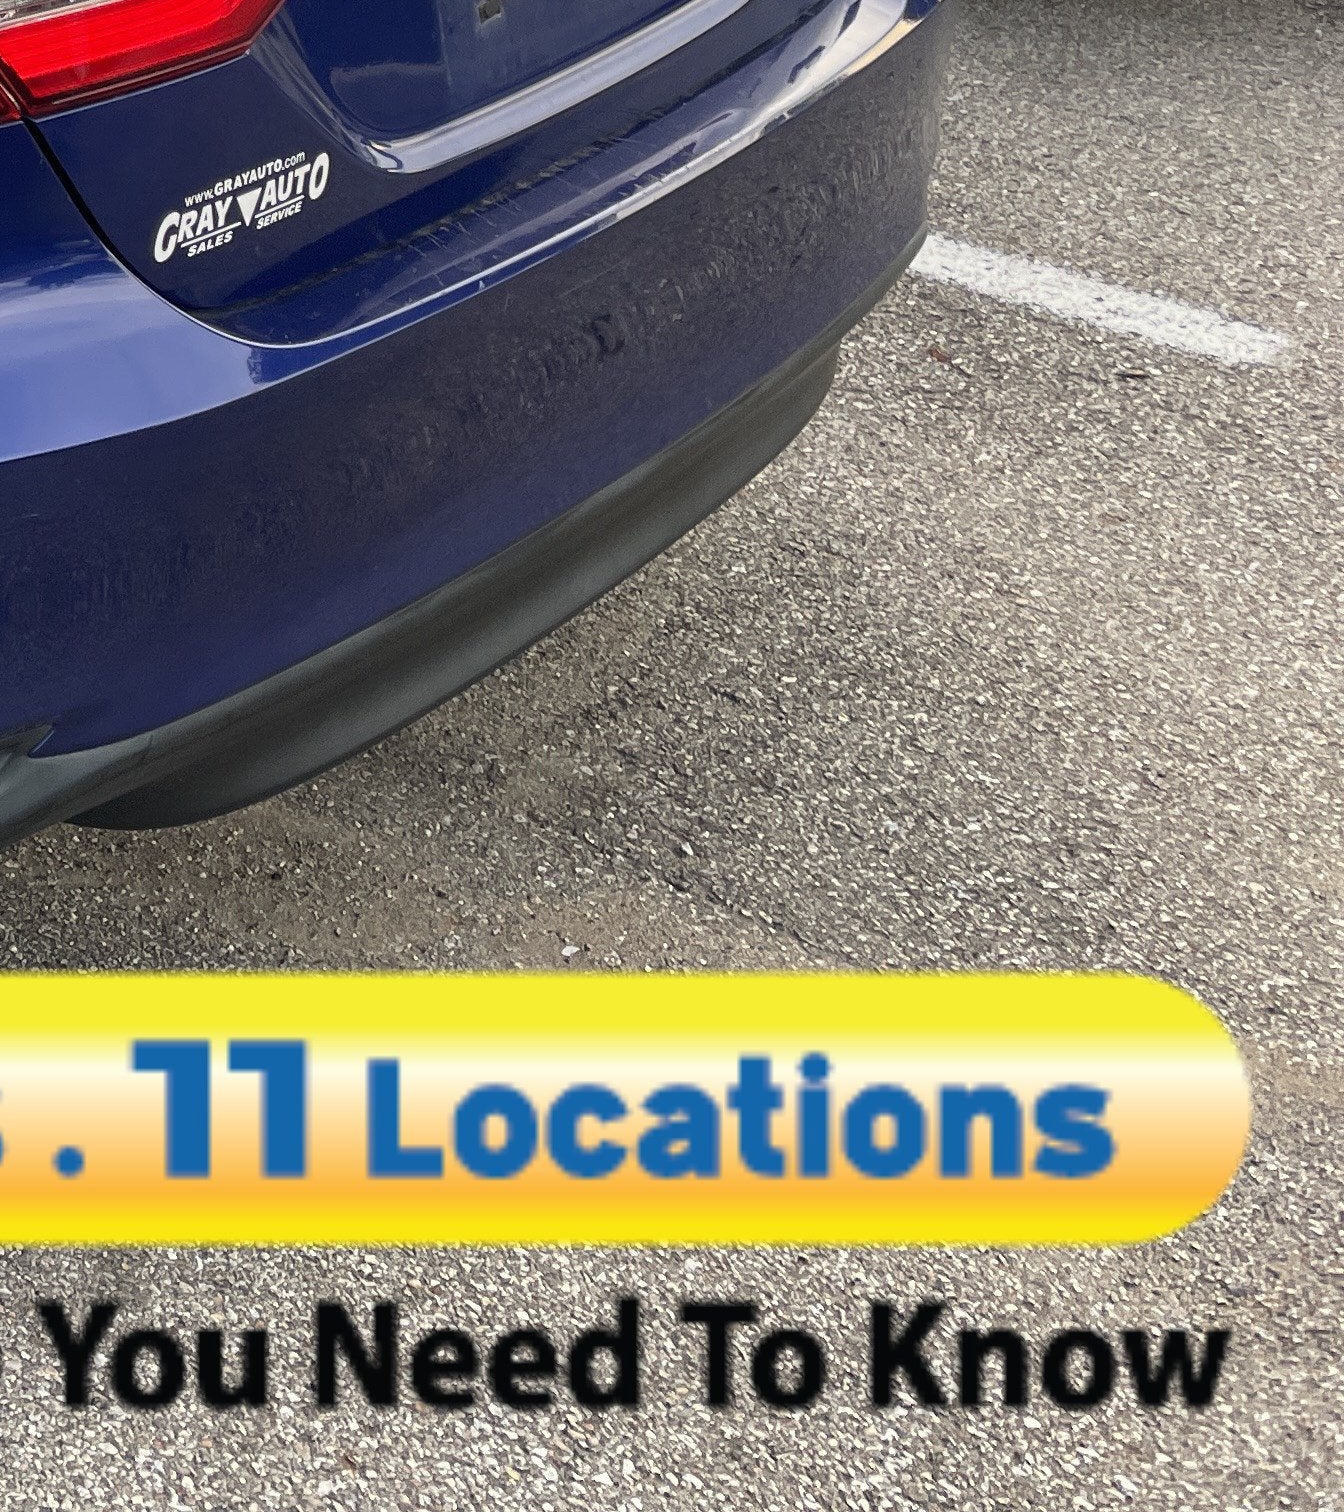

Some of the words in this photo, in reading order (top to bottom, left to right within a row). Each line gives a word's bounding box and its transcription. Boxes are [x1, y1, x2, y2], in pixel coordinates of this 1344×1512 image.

[184, 151, 306, 207] www.GRAYAUTO.com
[153, 195, 233, 263] GRAY
[260, 152, 330, 211] AUTO
[257, 201, 303, 230] SERVICE
[187, 231, 233, 258] SALES
